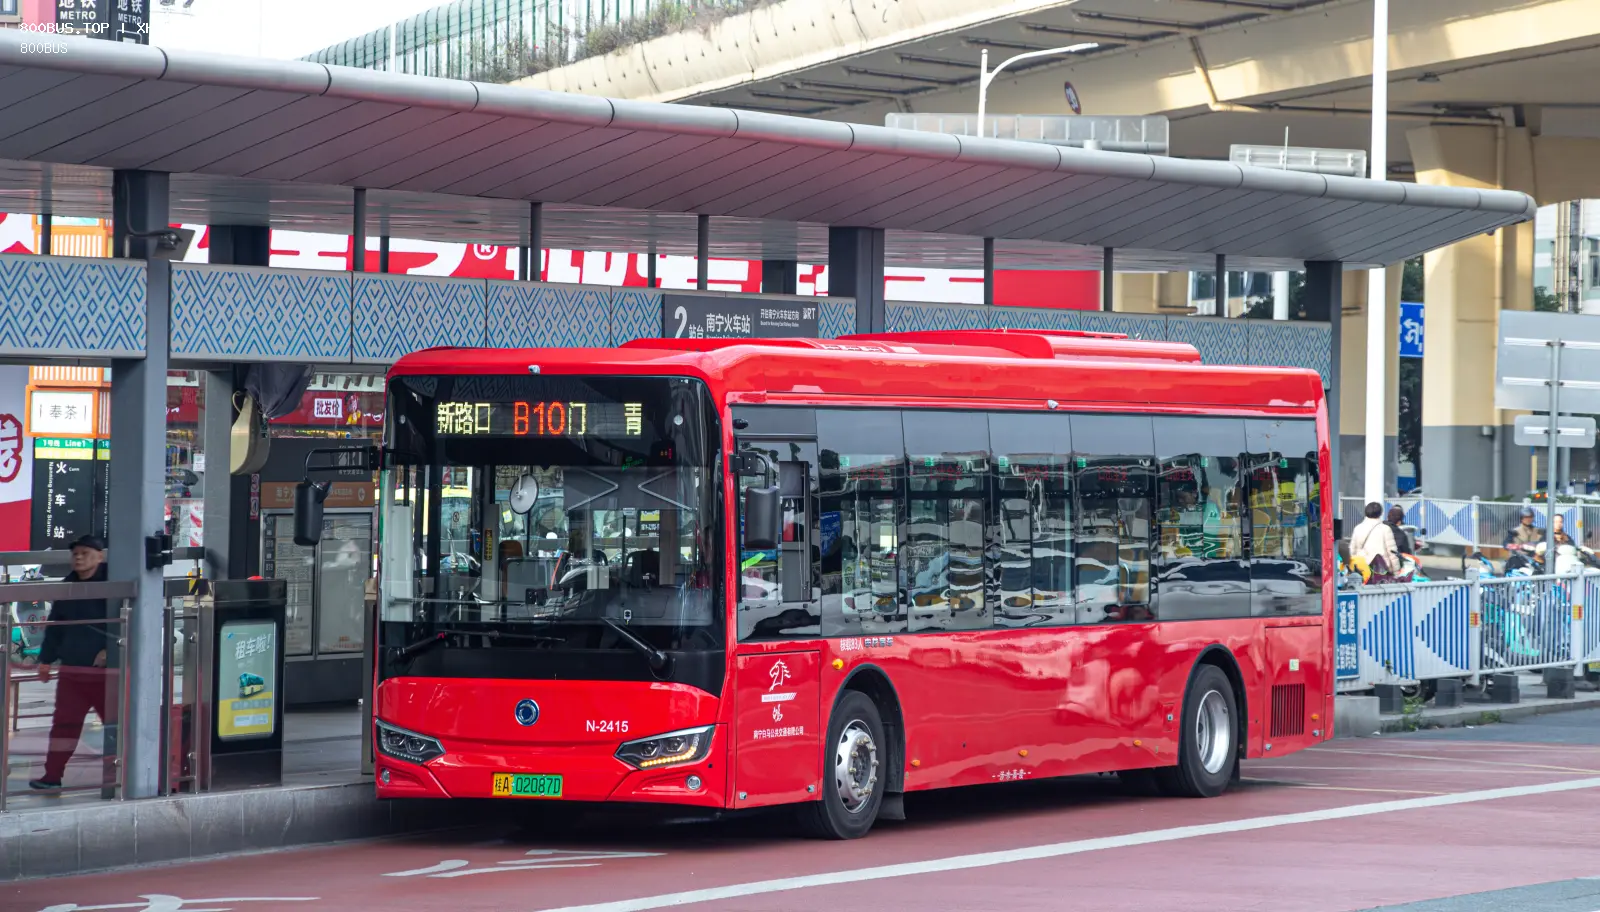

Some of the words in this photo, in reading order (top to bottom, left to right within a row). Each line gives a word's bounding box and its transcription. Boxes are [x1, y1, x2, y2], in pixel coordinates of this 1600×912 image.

[60, 11, 96, 20] METRO
[118, 13, 142, 24] METRO
[706, 313, 751, 334] 南宁火车站
[50, 405, 77, 420] 奉茶
[316, 400, 339, 416] 批发价
[437, 402, 491, 434] 新路口
[513, 402, 566, 435] B10
[624, 403, 643, 434] 青
[53, 461, 67, 539] 火车站
[234, 633, 271, 660] 租车啦!
[586, 720, 628, 732] N-2415
[495, 775, 510, 792] 桂A
[516, 777, 560, 793] 02087D
